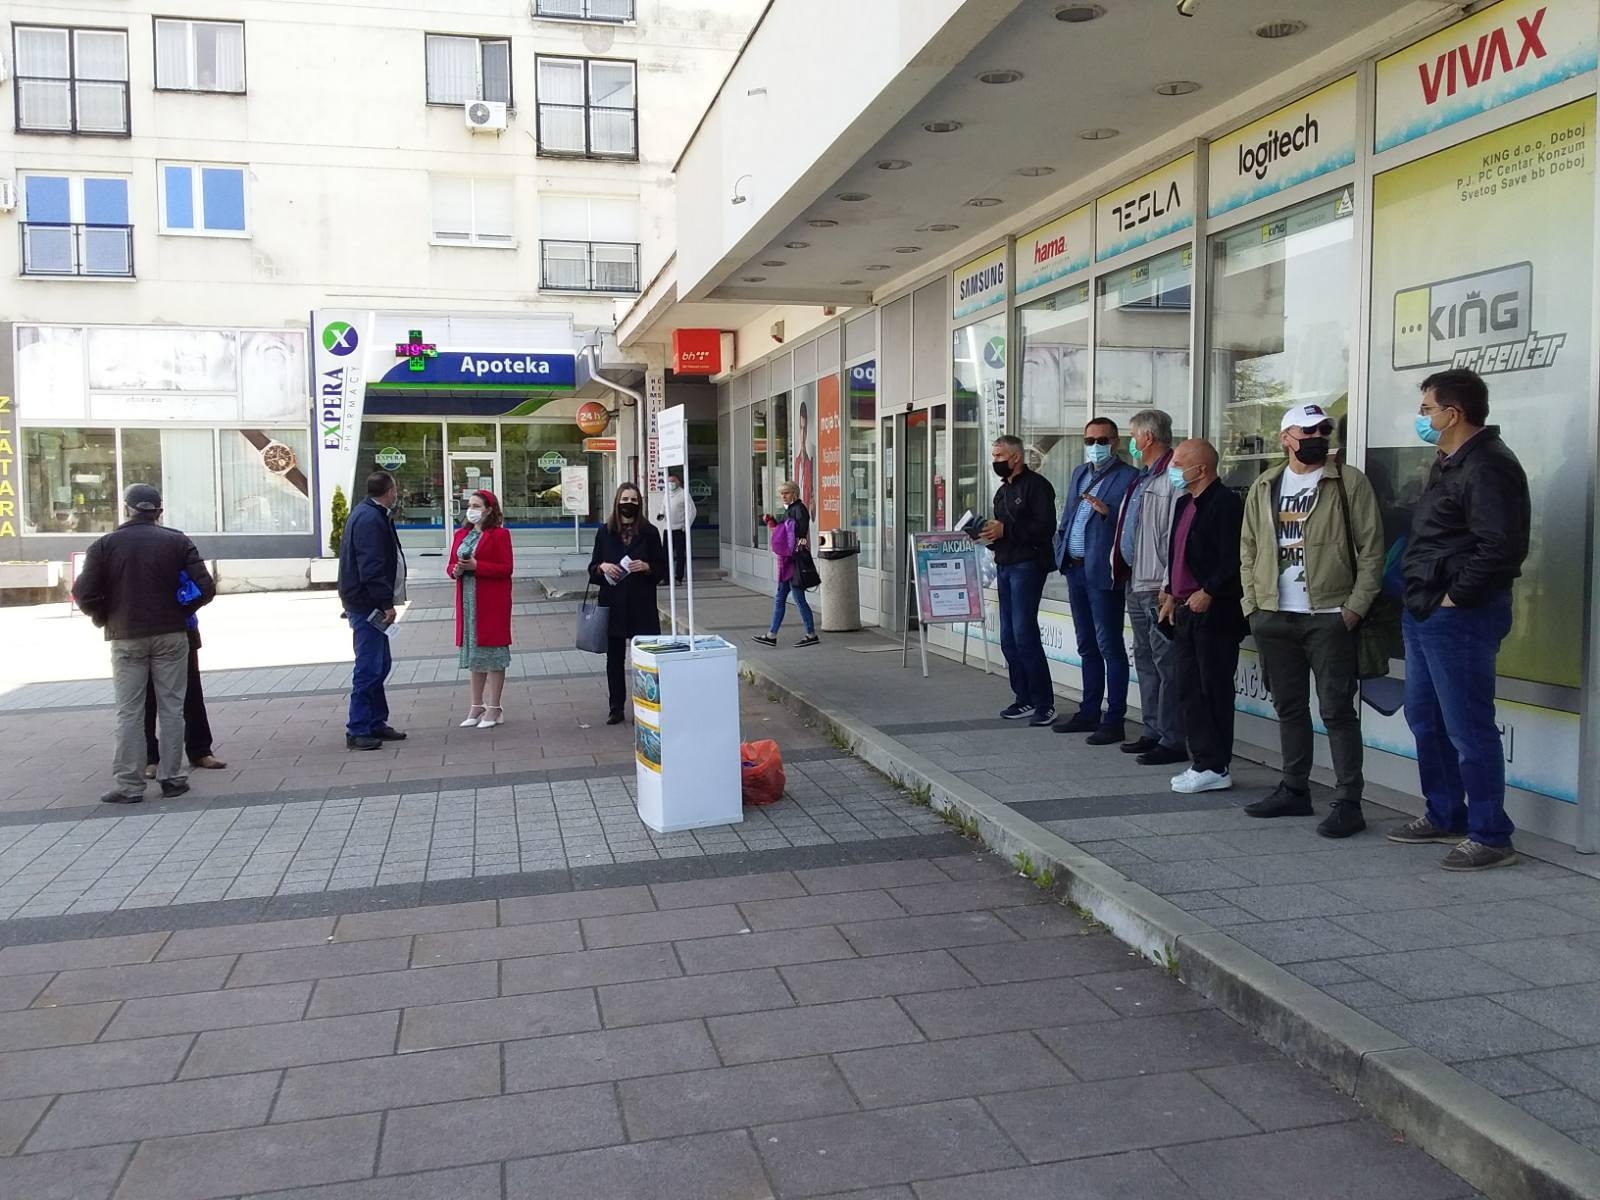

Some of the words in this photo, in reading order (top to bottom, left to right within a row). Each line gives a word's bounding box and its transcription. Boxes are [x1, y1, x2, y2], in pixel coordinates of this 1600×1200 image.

[1418, 6, 1548, 106] VIVAX
[1238, 112, 1319, 180] logitech
[1457, 176, 1475, 190] P.J.
[1478, 169, 1493, 183] PC
[1497, 158, 1533, 177] Centar
[1538, 140, 1585, 164] Konzum
[1482, 149, 1510, 168] KING
[1513, 139, 1546, 157] d.o.o.
[1550, 122, 1586, 146] Doboj
[1461, 183, 1497, 202] Svetog
[1500, 173, 1528, 190] Save
[1531, 165, 1546, 180] bb
[1550, 156, 1585, 174] Doboj
[1112, 181, 1181, 233] TESLA
[1033, 235, 1066, 265] hama
[960, 262, 1004, 301] SAMSUNG
[1430, 290, 1519, 342] KING
[460, 355, 550, 377] Apoteka
[320, 366, 344, 450] EXPERA
[344, 366, 360, 452] PHARMACY
[580, 411, 592, 421] 24
[1040, 624, 1064, 649] ERVIS
